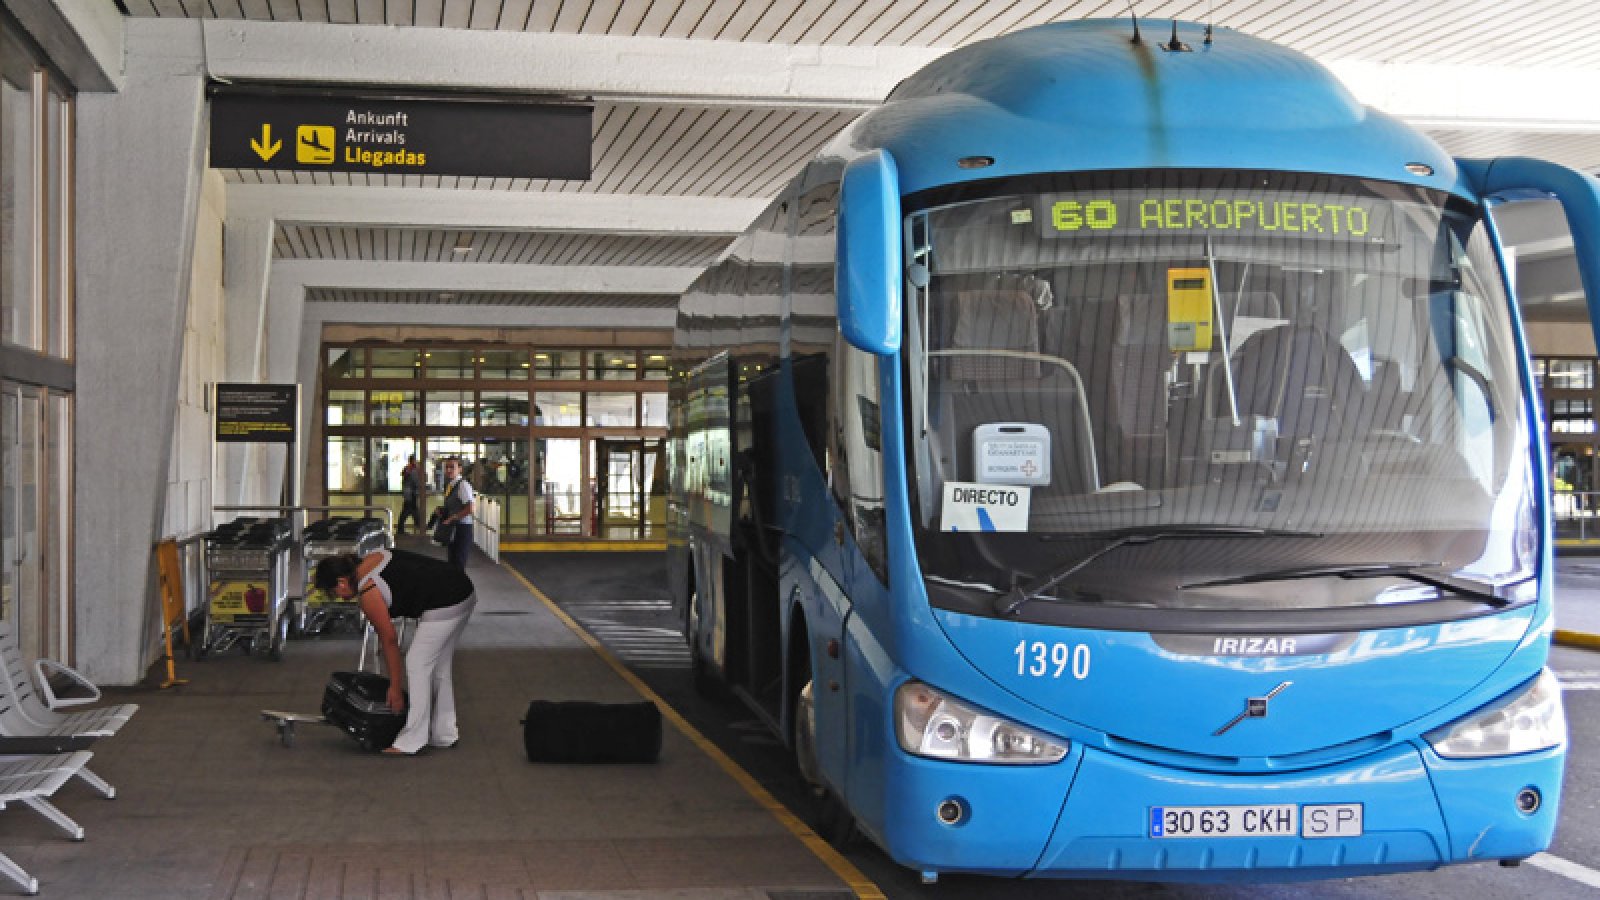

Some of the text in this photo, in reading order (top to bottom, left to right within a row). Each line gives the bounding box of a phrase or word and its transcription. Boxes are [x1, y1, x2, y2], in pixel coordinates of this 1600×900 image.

[346, 110, 408, 127] Ankunft
[346, 128, 406, 145] Arrivals
[345, 147, 426, 167] Llegadas
[1052, 199, 1368, 236] 60 AEROPUERTO
[953, 487, 1019, 506] DIRECTO
[1213, 637, 1297, 654] IRIZAR
[1014, 639, 1091, 680] 1390
[1242, 809, 1291, 833] CKH
